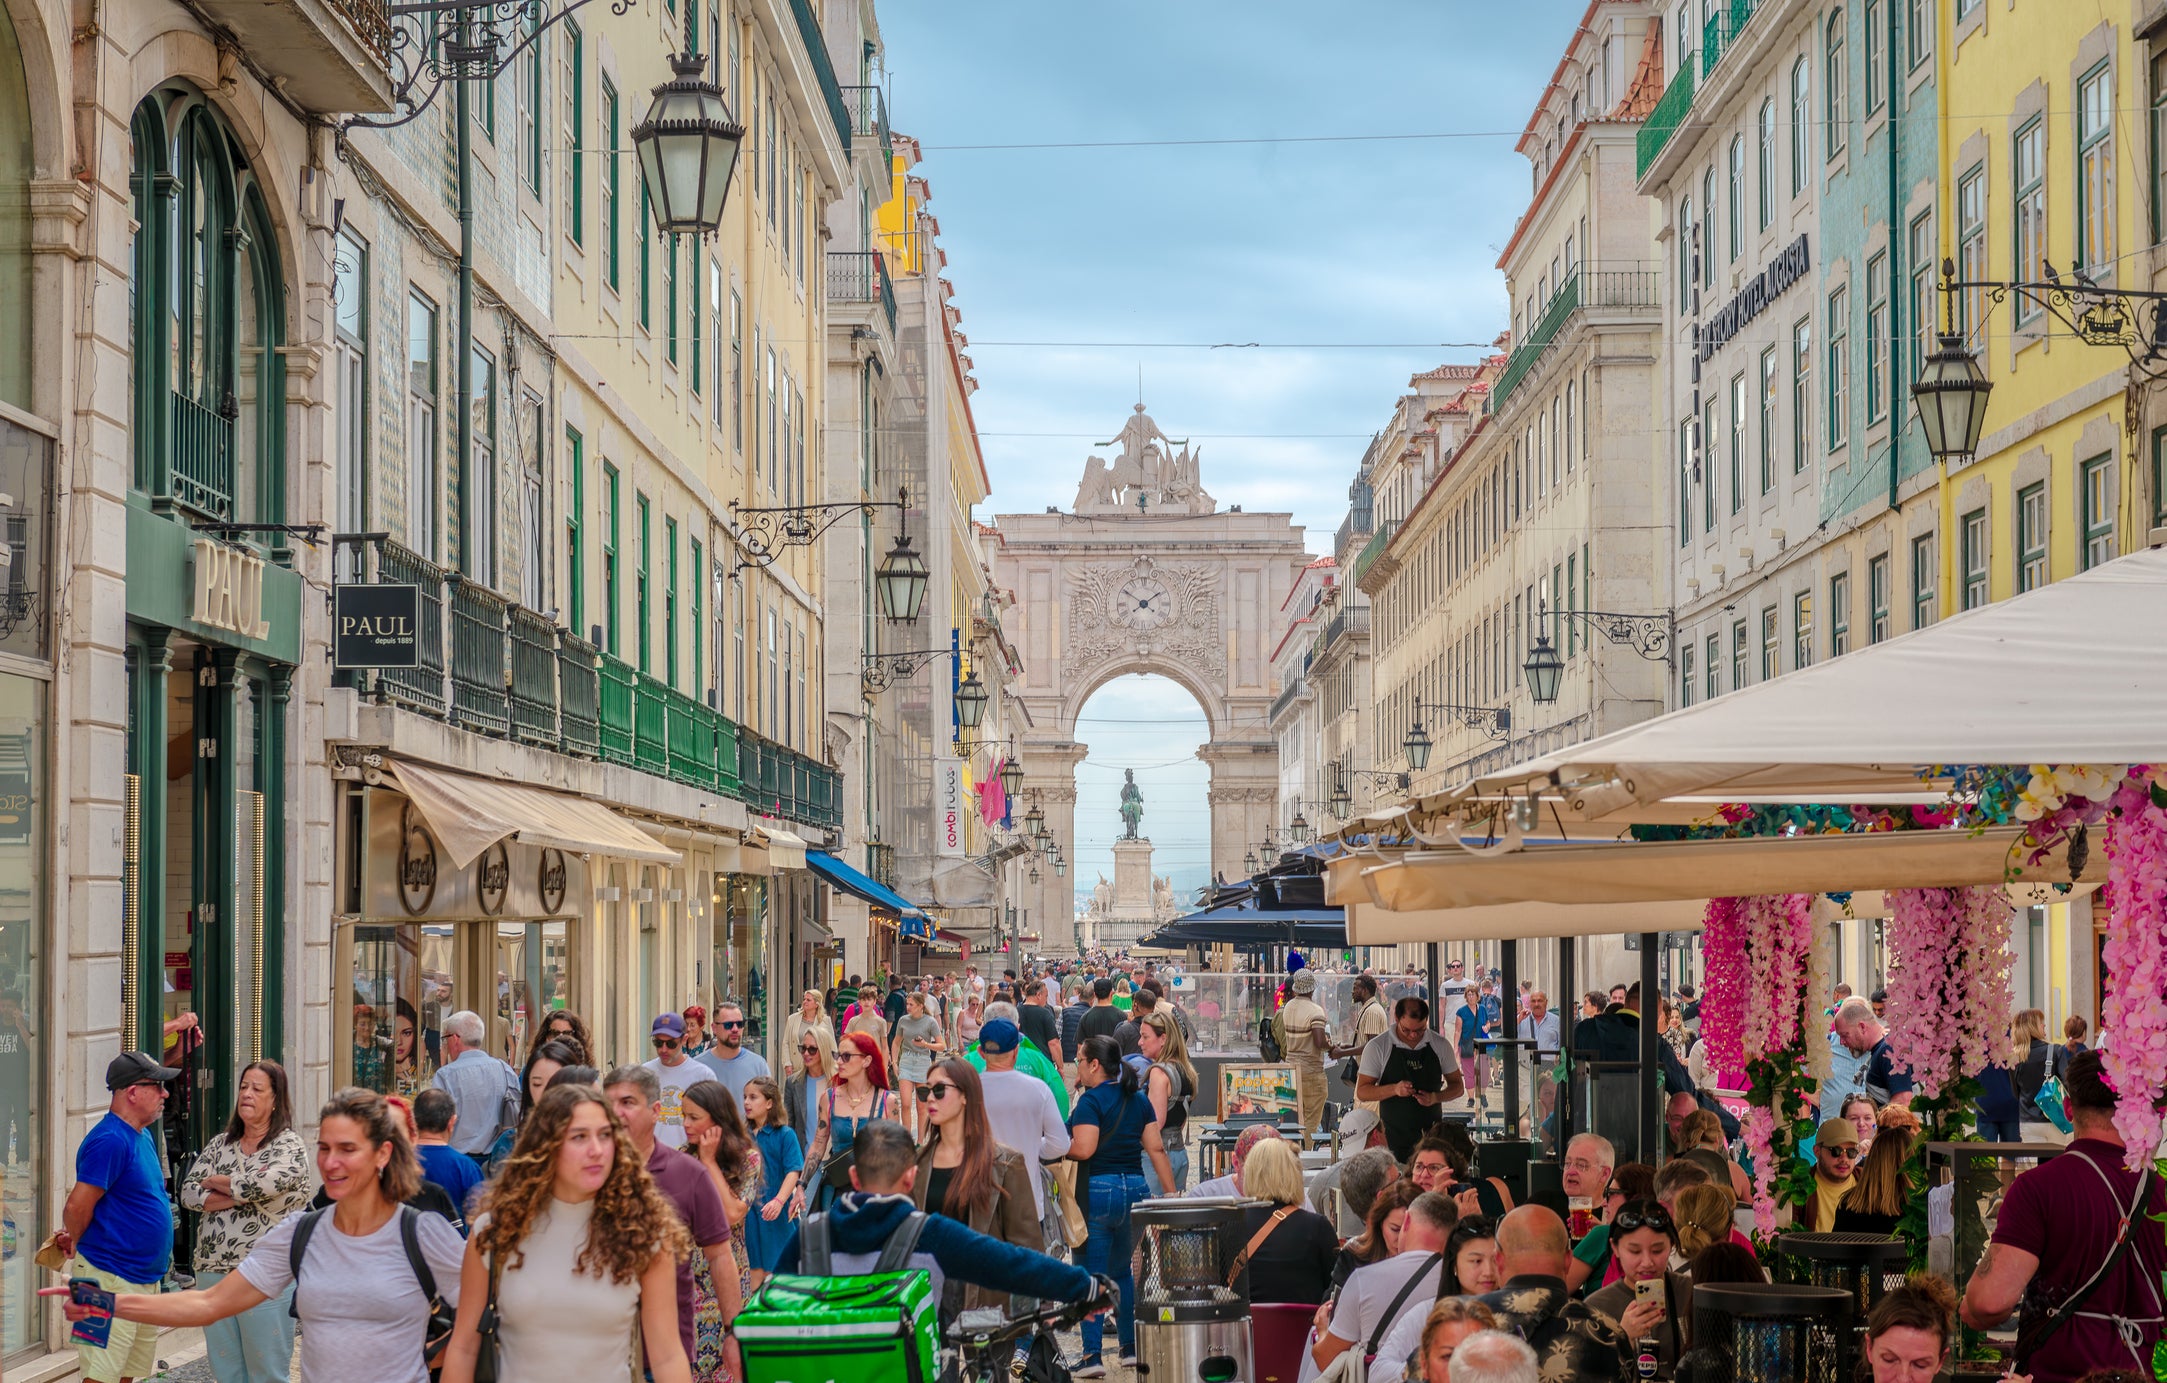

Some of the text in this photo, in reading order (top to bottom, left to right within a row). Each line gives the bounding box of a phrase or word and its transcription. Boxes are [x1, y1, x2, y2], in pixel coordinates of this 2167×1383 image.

[1701, 232, 1810, 363] MY STORY HOTEL AUGUSTA
[192, 538, 270, 641] PAUL
[341, 616, 414, 636] PAUL
[375, 637, 396, 645] depuis
